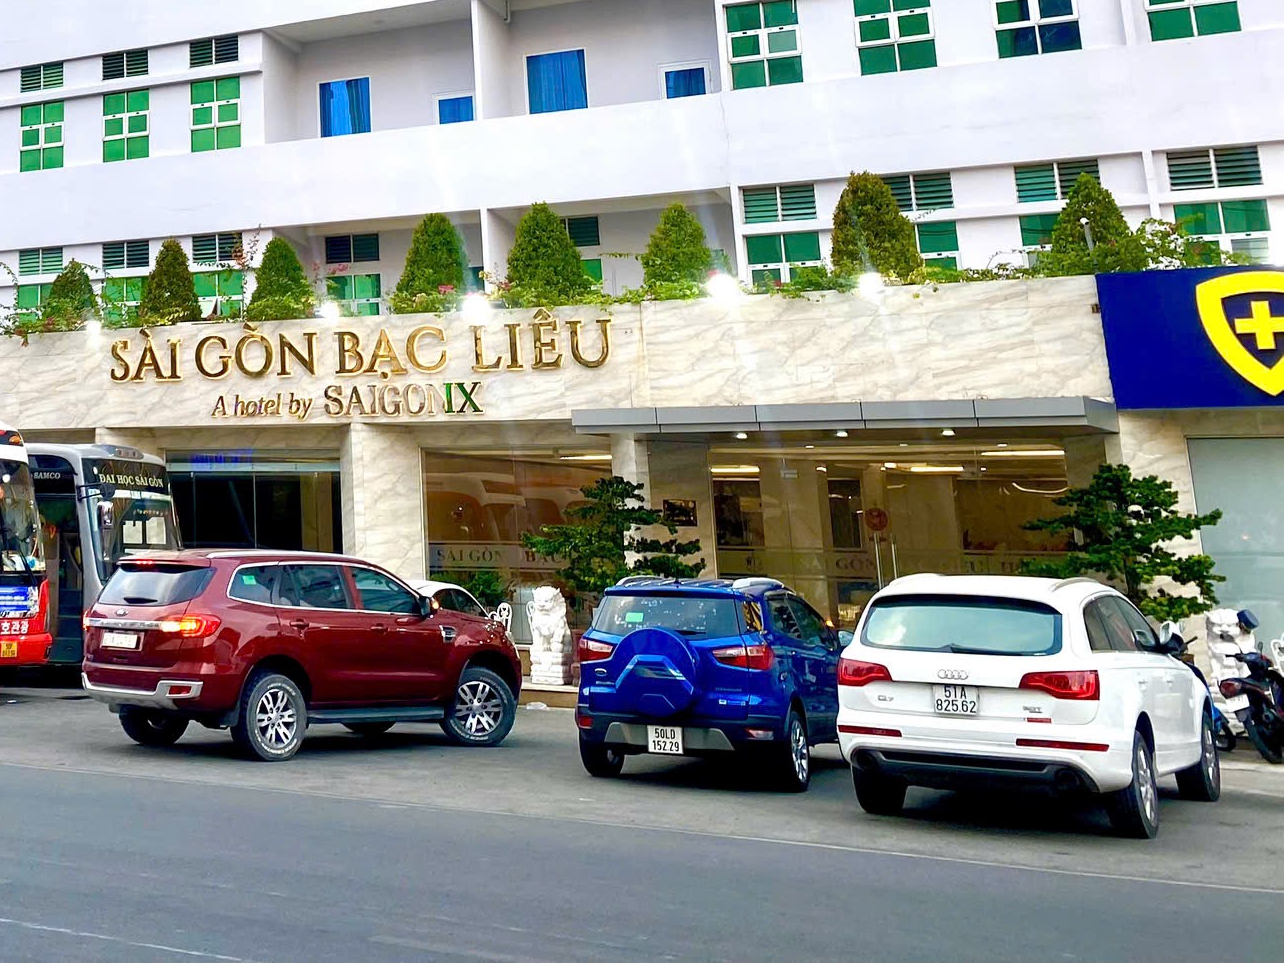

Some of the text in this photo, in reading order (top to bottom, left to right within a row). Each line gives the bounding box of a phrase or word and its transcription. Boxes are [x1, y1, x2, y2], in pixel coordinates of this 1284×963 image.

[110, 307, 613, 382] SÀI GÒN BẠC LIÊU
[211, 381, 485, 421] A hotel by SAIGONIX
[33, 471, 61, 480] SAMCO
[943, 686, 967, 700] 51A
[935, 699, 977, 714] 825.62
[654, 728, 676, 740] 50LD
[652, 740, 680, 752] 152.29
